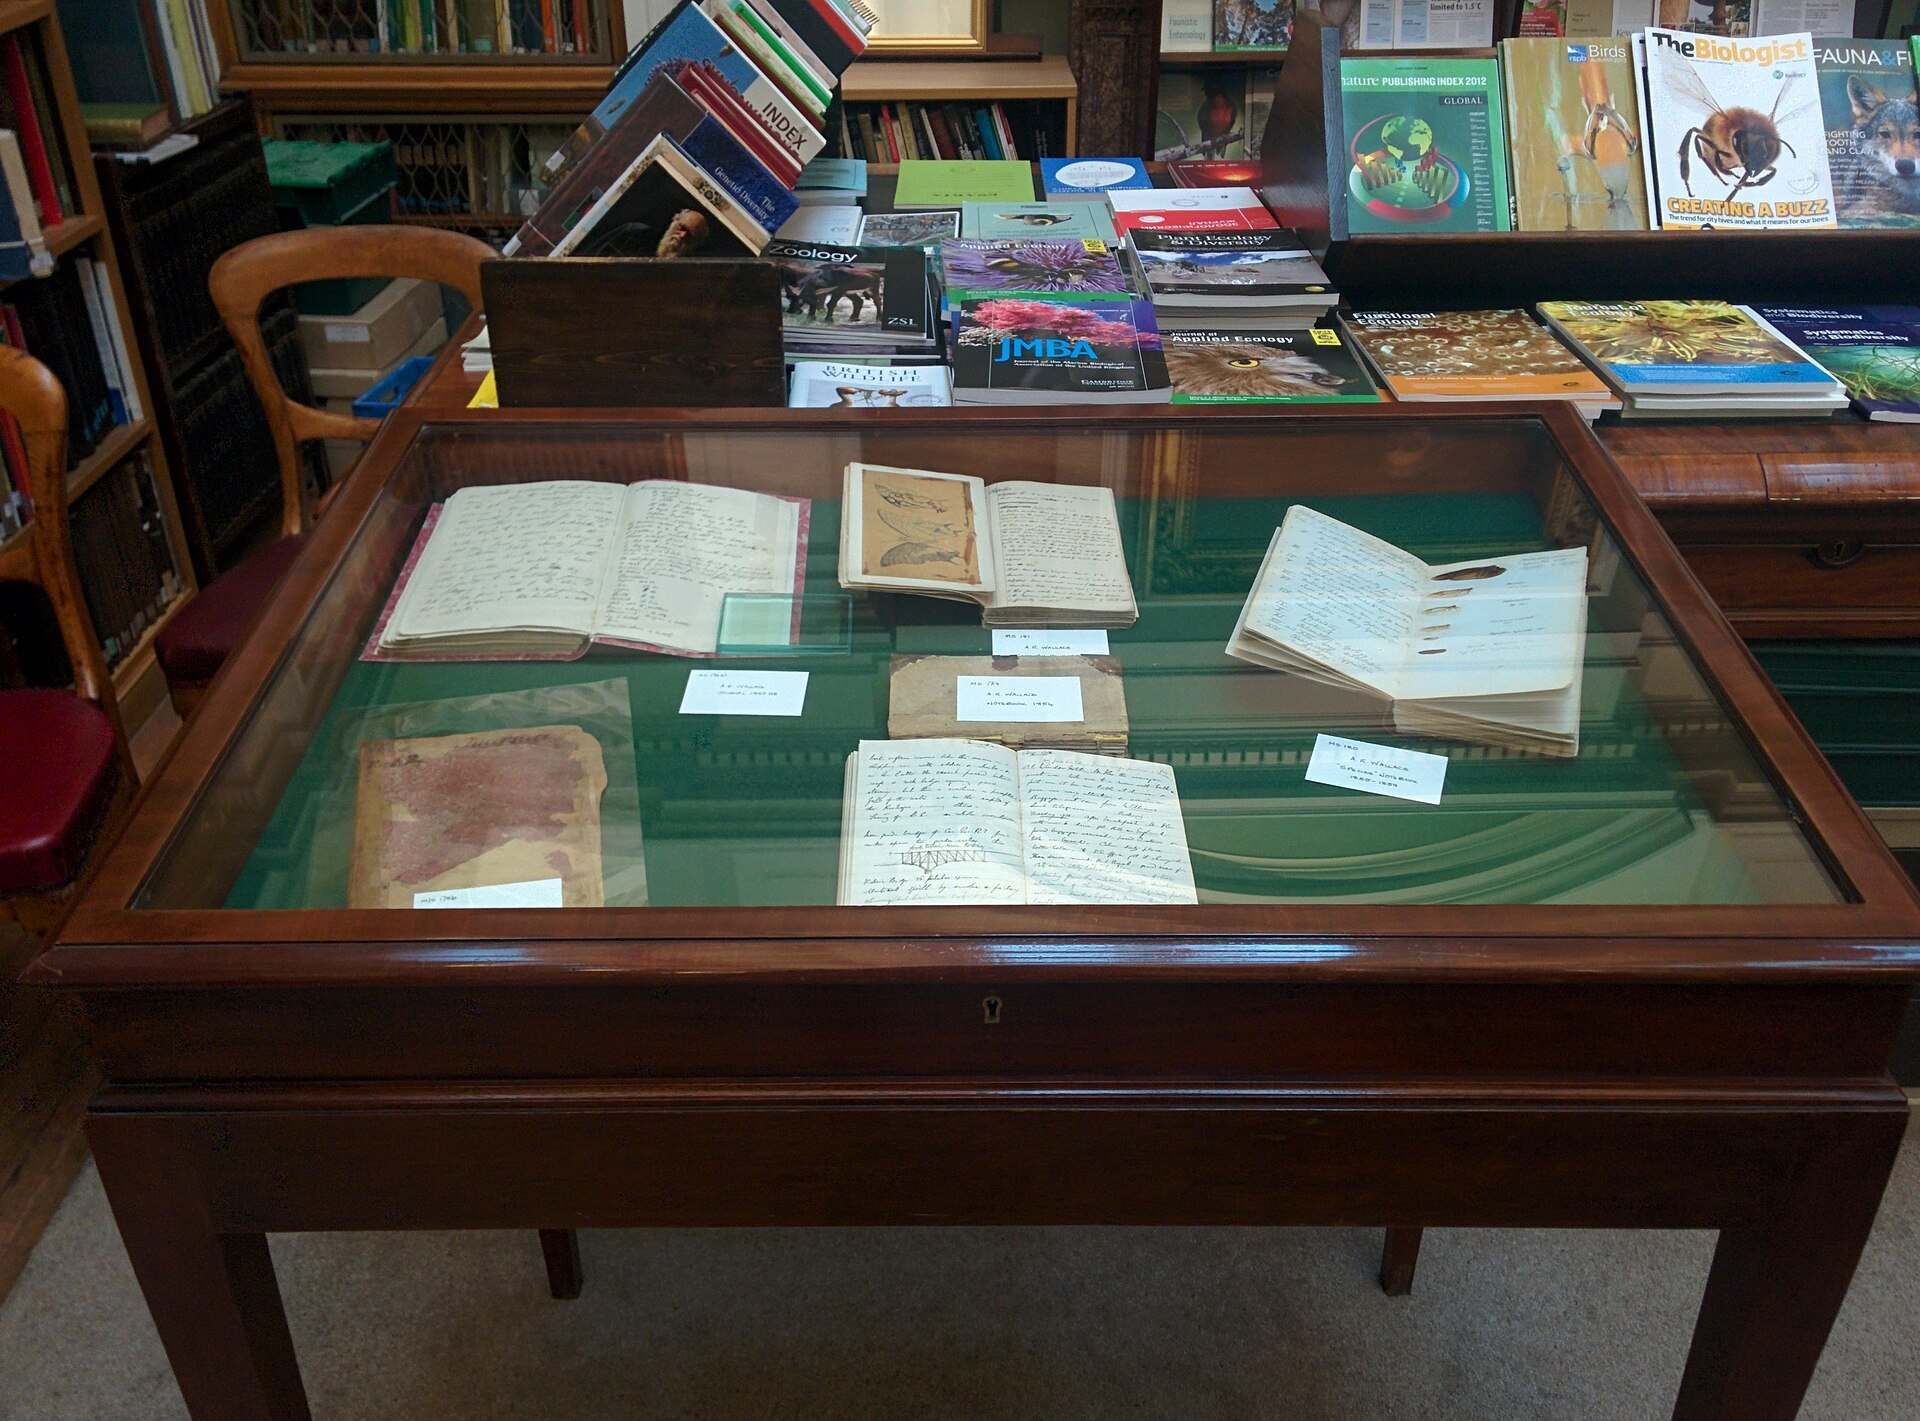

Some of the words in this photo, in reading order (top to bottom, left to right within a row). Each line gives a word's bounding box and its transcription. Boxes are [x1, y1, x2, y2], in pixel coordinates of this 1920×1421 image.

[1589, 44, 1626, 57] Birds
[1382, 77, 1436, 86] PUBLISHING
[1437, 77, 1464, 86] INDEX
[1465, 76, 1487, 86] 2012
[1444, 97, 1483, 105] GLOBAL
[761, 102, 808, 150] INDEX
[762, 195, 776, 213] The
[1667, 197, 1755, 217] CREATING
[1758, 202, 1773, 217] A
[1775, 199, 1831, 217] BUZZ
[1680, 214, 1696, 222] trend
[1707, 216, 1718, 225] city
[1718, 216, 1733, 224] hives
[1812, 215, 1829, 223] bees
[1158, 233, 1202, 241] Plant
[1206, 233, 1272, 243] Ecology
[1189, 239, 1265, 248] Diversity
[769, 245, 858, 263] Zoology
[1352, 312, 1436, 320] Functional
[1357, 318, 1420, 327] Ecology
[1172, 336, 1230, 344] Applied
[1235, 336, 1294, 345] Ecology
[993, 337, 1099, 362] JMBA
